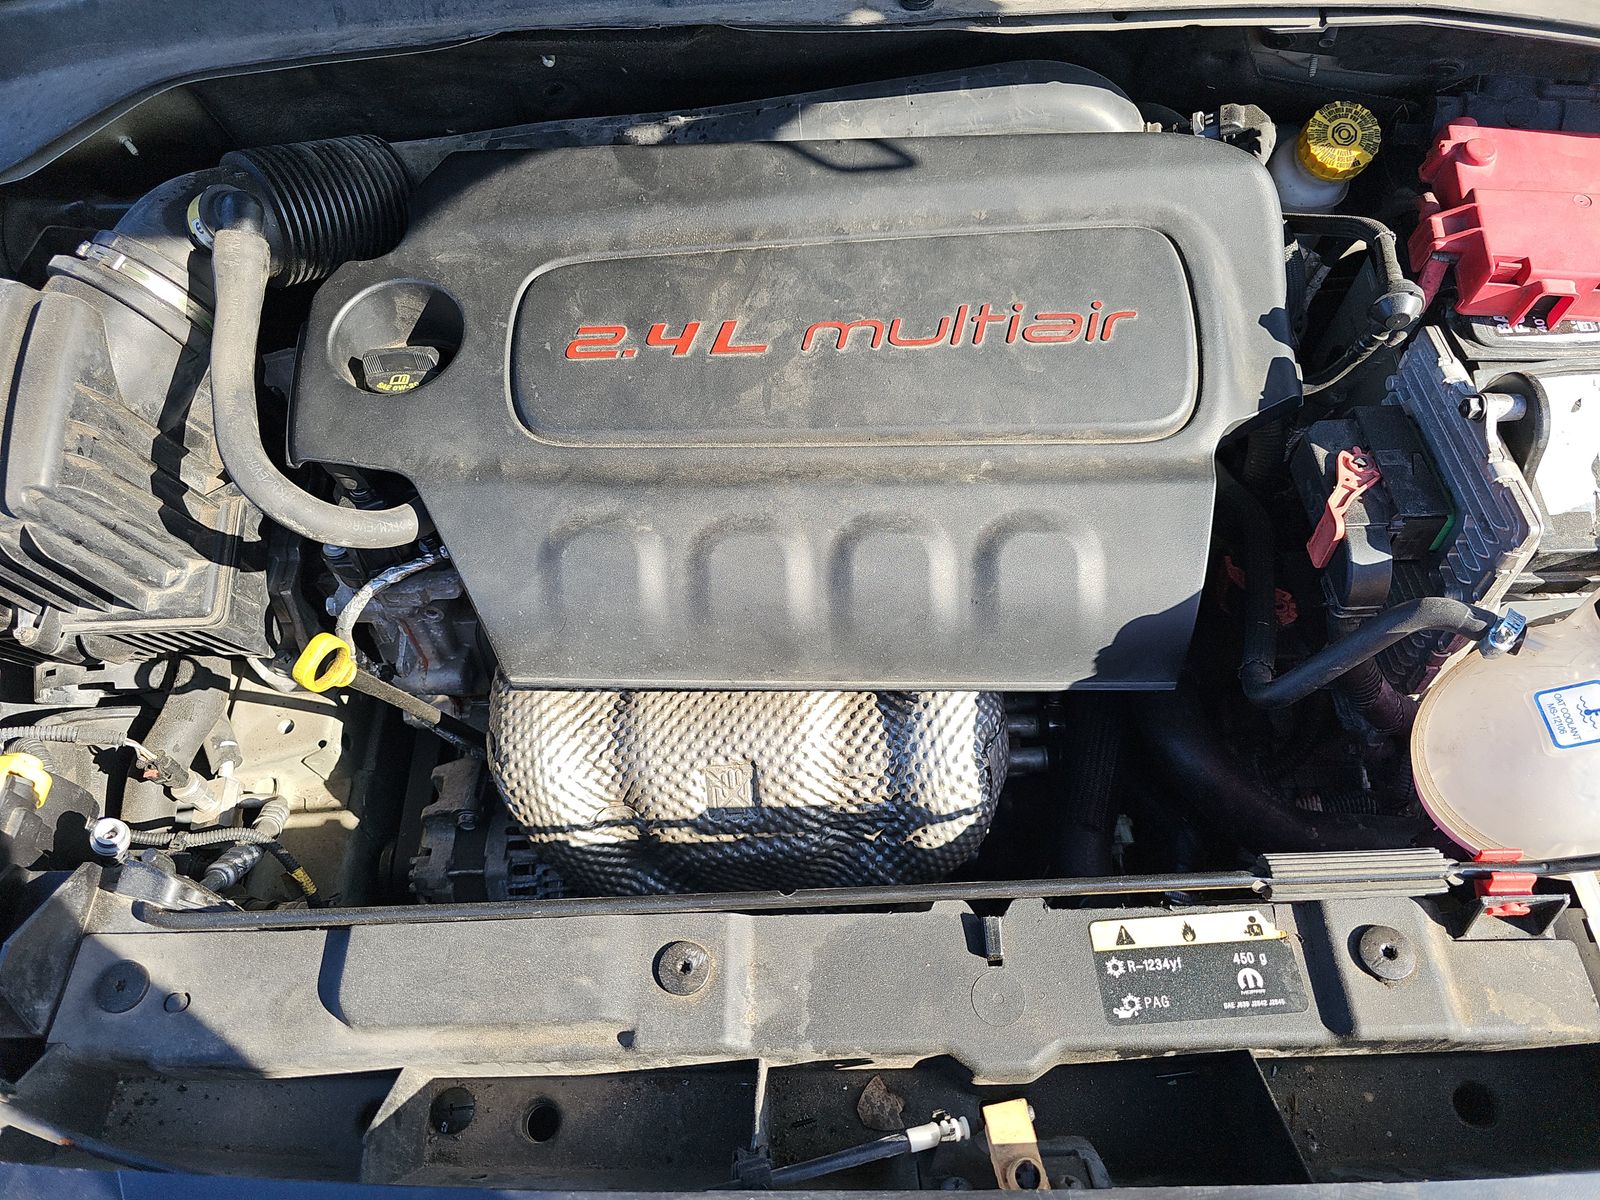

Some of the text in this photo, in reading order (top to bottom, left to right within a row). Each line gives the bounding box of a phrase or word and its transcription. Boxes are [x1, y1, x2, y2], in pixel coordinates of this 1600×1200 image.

[801, 300, 1137, 351] multiair
[1547, 703, 1567, 735] MS-12106
[1553, 693, 1582, 740] OAT COOLANT
[1127, 956, 1182, 974] R-1234yf
[1232, 951, 1268, 966] 450 g
[1144, 995, 1170, 1009] PAG
